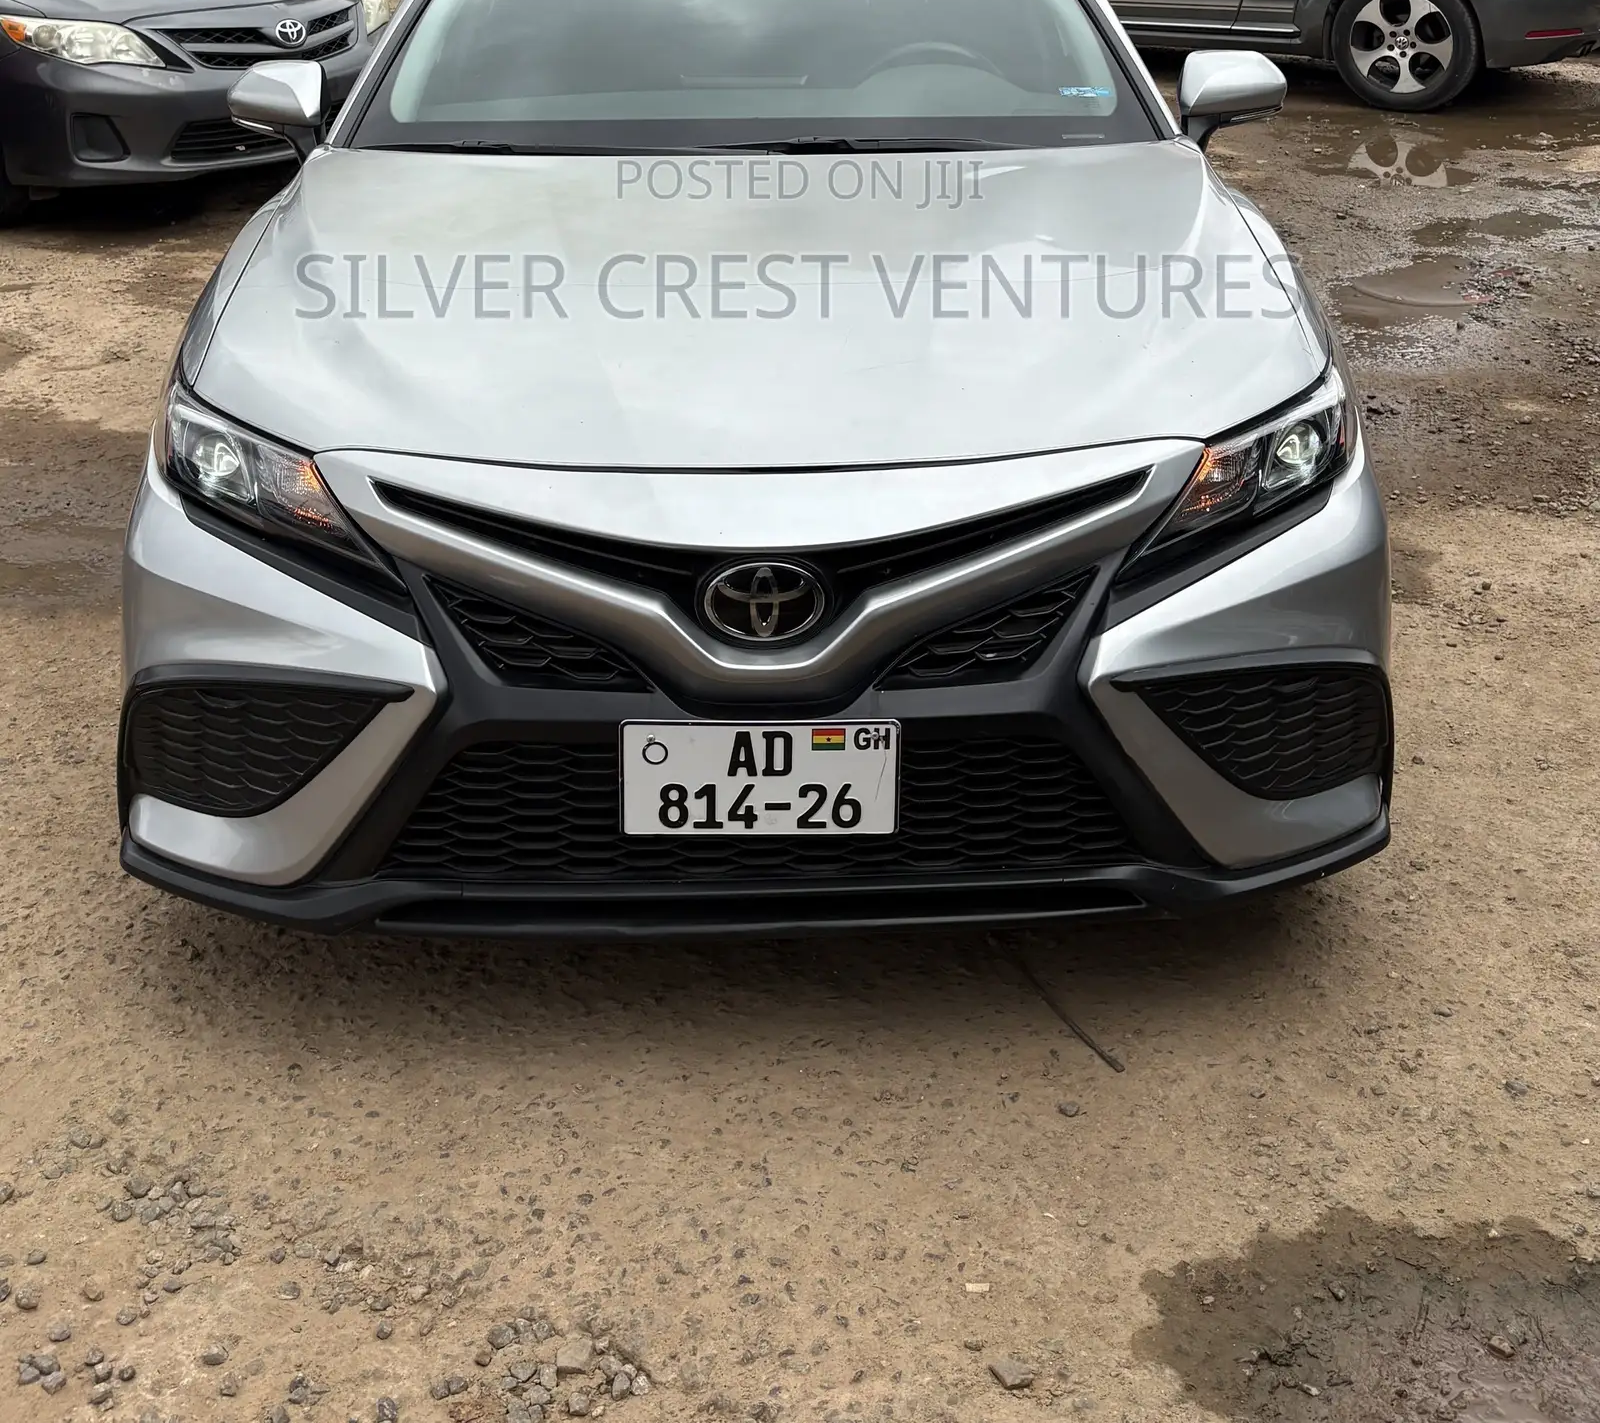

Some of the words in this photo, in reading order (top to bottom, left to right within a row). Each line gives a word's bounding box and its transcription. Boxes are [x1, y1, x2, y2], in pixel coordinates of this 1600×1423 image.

[727, 730, 793, 777] AD
[853, 727, 891, 751] GH
[658, 783, 862, 830] 814-26
